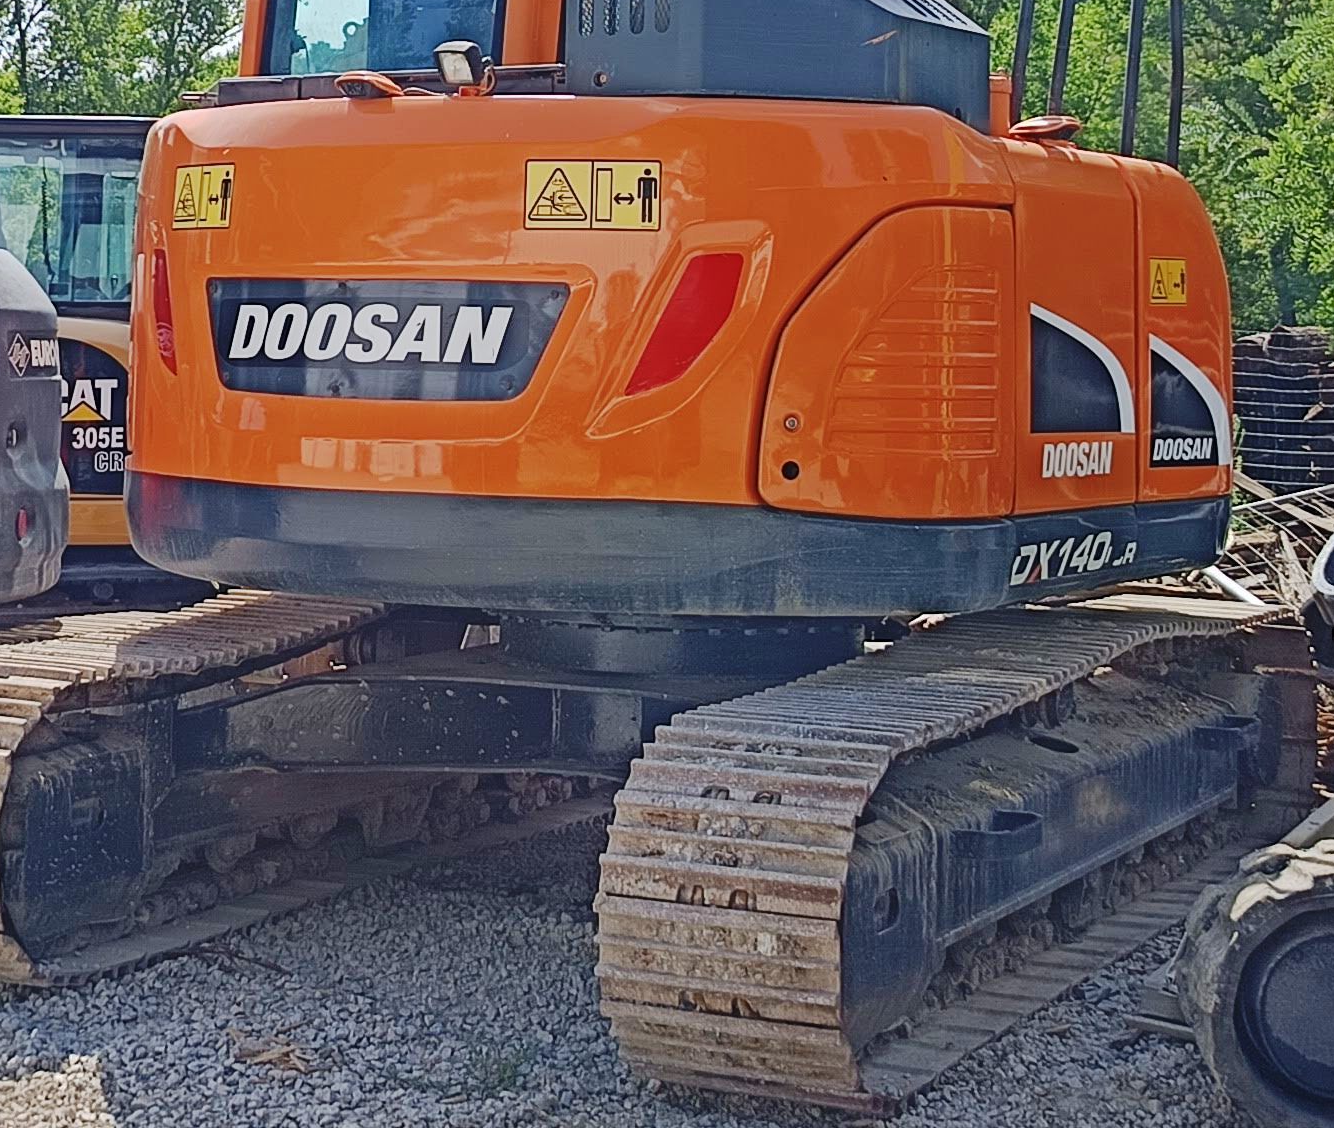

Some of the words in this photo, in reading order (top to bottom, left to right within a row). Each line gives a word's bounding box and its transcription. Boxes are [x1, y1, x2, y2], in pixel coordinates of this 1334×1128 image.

[228, 303, 515, 364] DOOSAN
[71, 426, 124, 449] 305E
[1153, 437, 1213, 461] DOOSAN
[94, 451, 124, 472] CR
[1042, 441, 1113, 478] DOOSAN
